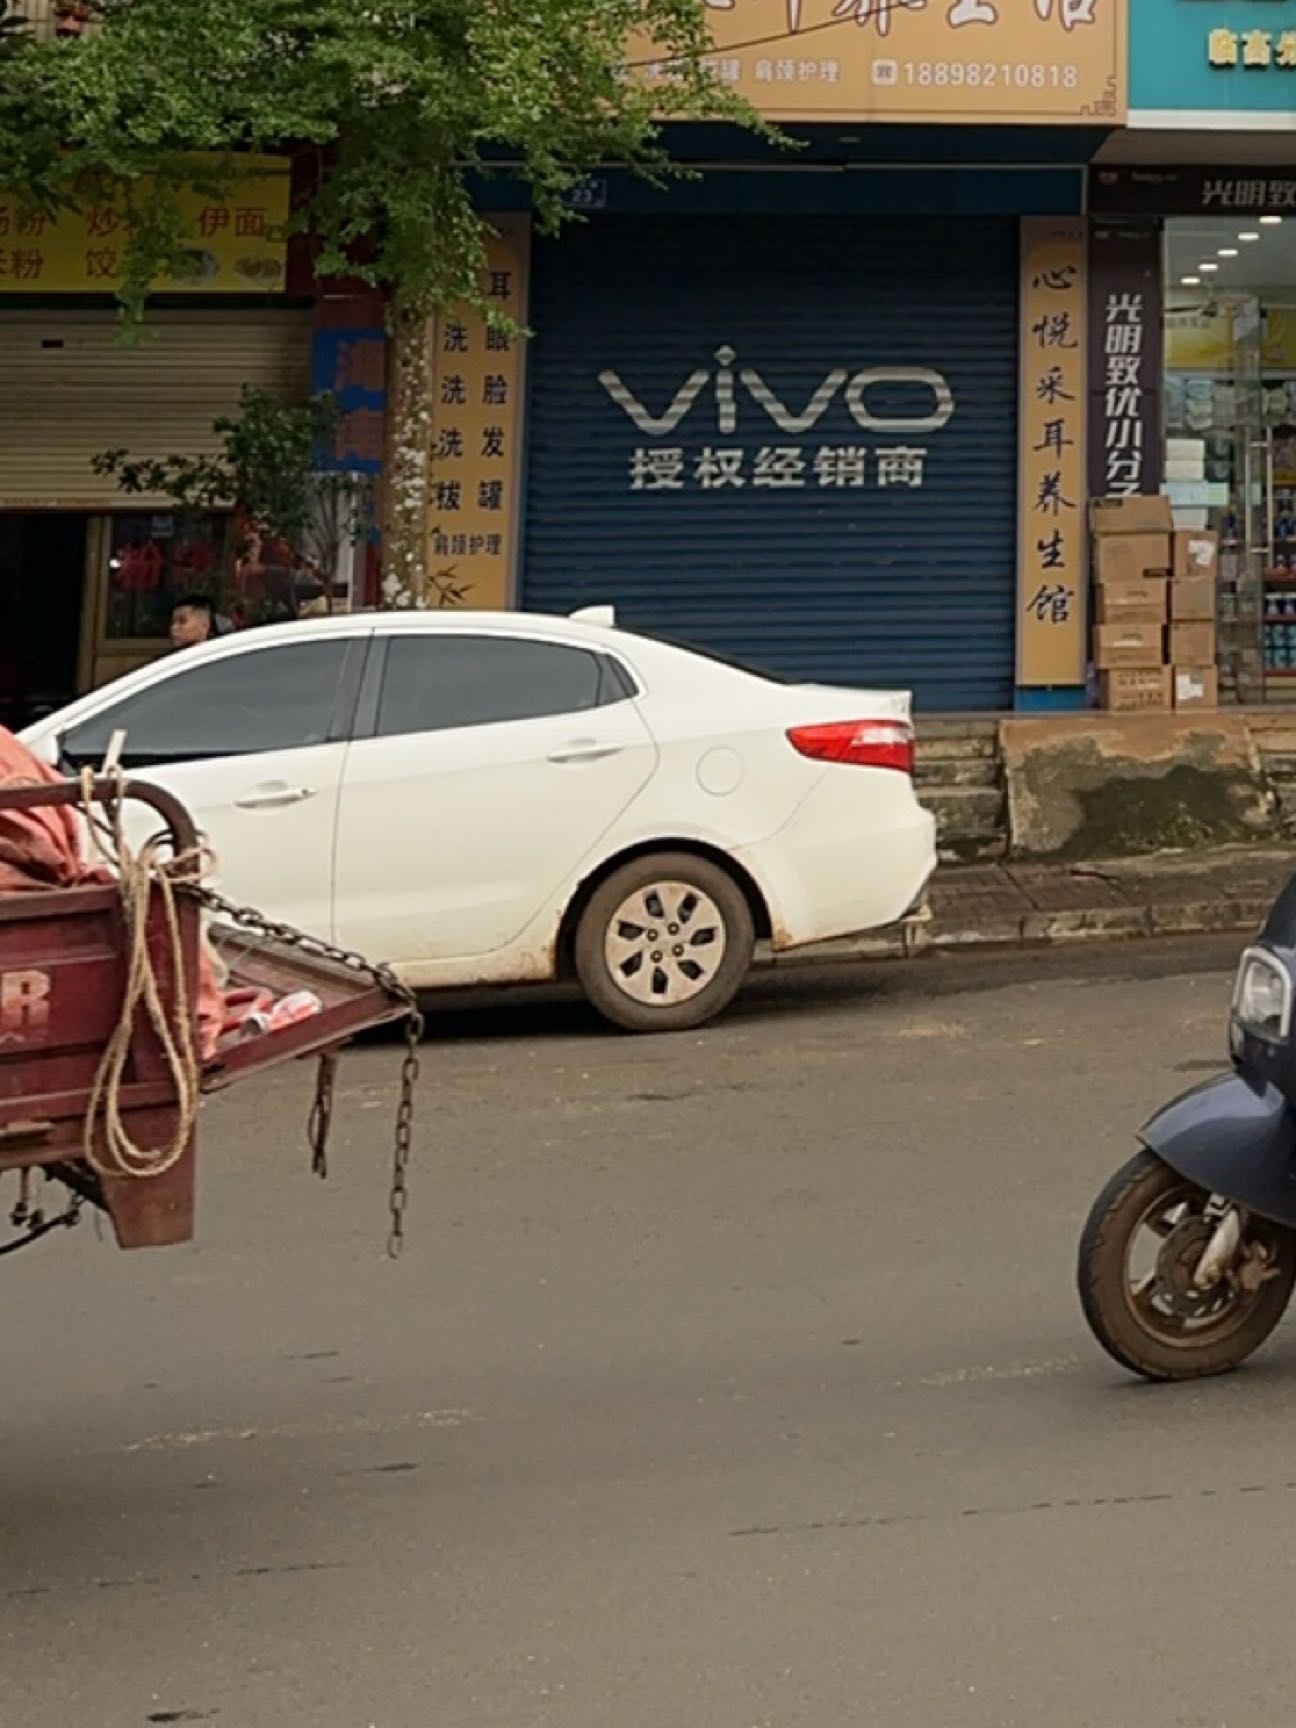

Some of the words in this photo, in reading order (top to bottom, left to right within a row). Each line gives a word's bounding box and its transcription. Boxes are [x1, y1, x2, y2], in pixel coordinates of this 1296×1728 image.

[904, 61, 1078, 88] 18898210818
[598, 344, 956, 434] vivo
[629, 446, 928, 490] 授权经销商
